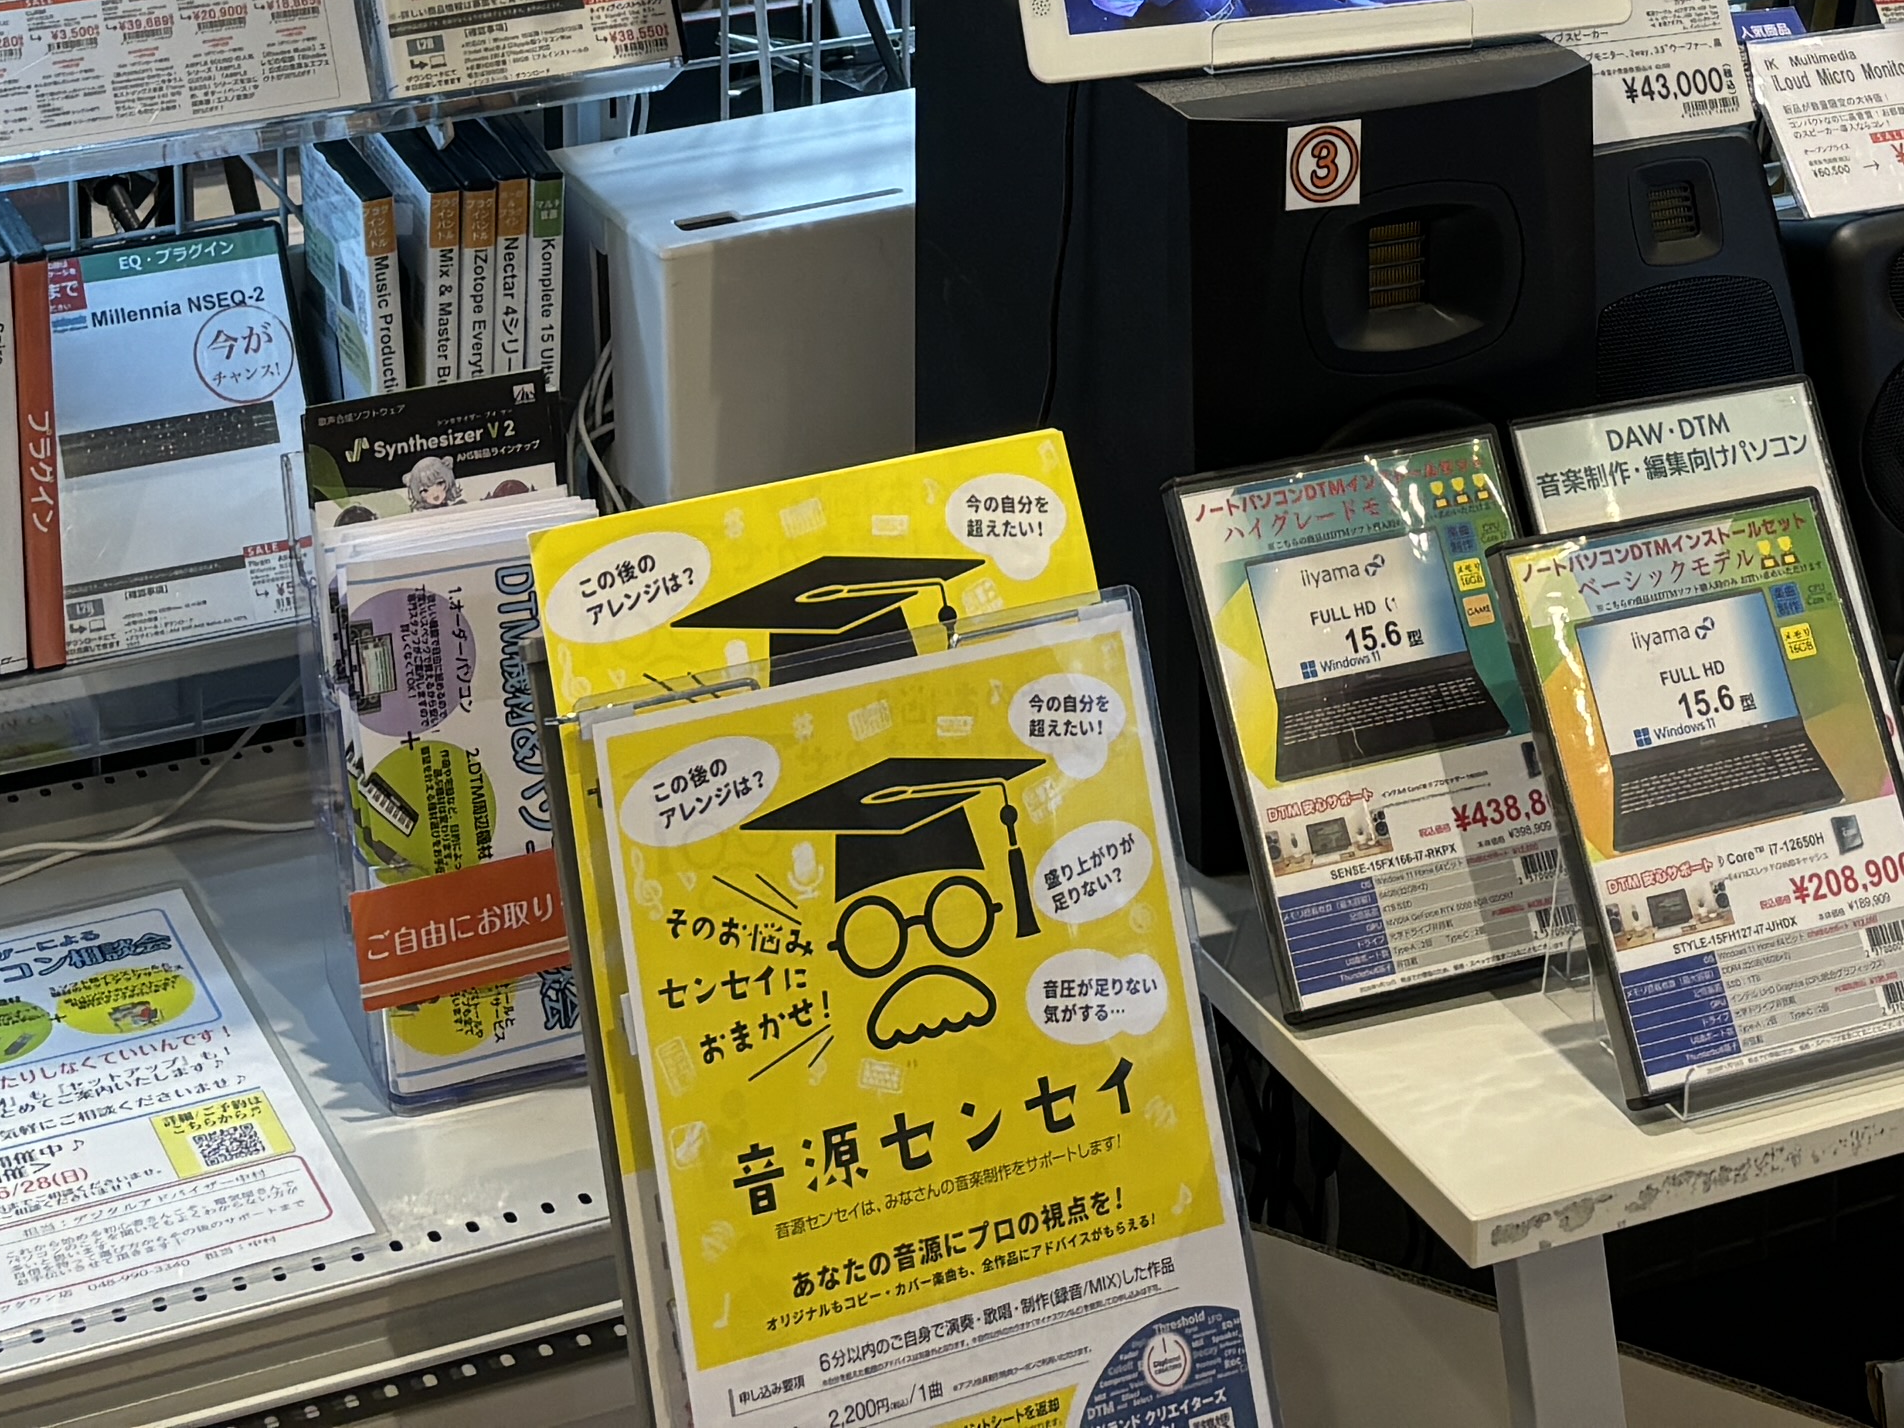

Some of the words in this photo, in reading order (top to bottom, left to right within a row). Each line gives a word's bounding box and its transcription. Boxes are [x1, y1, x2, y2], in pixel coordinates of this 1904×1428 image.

[1741, 23, 1791, 41] 人気商品
[1622, 65, 1725, 104] ¥43,000
[117, 240, 235, 272] EQ・プラグイン
[90, 299, 183, 331] Millennia
[187, 285, 266, 314] NSEQ-2
[27, 410, 57, 535] プラグイン
[1535, 433, 1809, 500] 音楽制作・編集向けパソコン
[964, 494, 1050, 519] 今の自分を
[580, 555, 657, 599] この後の
[1300, 562, 1361, 589] iiyama
[1577, 550, 1756, 597] ベーシックモデル
[1630, 622, 1691, 652] iiyama
[1660, 662, 1701, 687] FULL
[1703, 659, 1726, 680] HD
[1027, 693, 1111, 718] 今の自分を
[658, 966, 809, 1012] センセイに
[1042, 975, 1158, 1004] 音圧が足りない
[732, 1056, 1139, 1218] 音源センセイ
